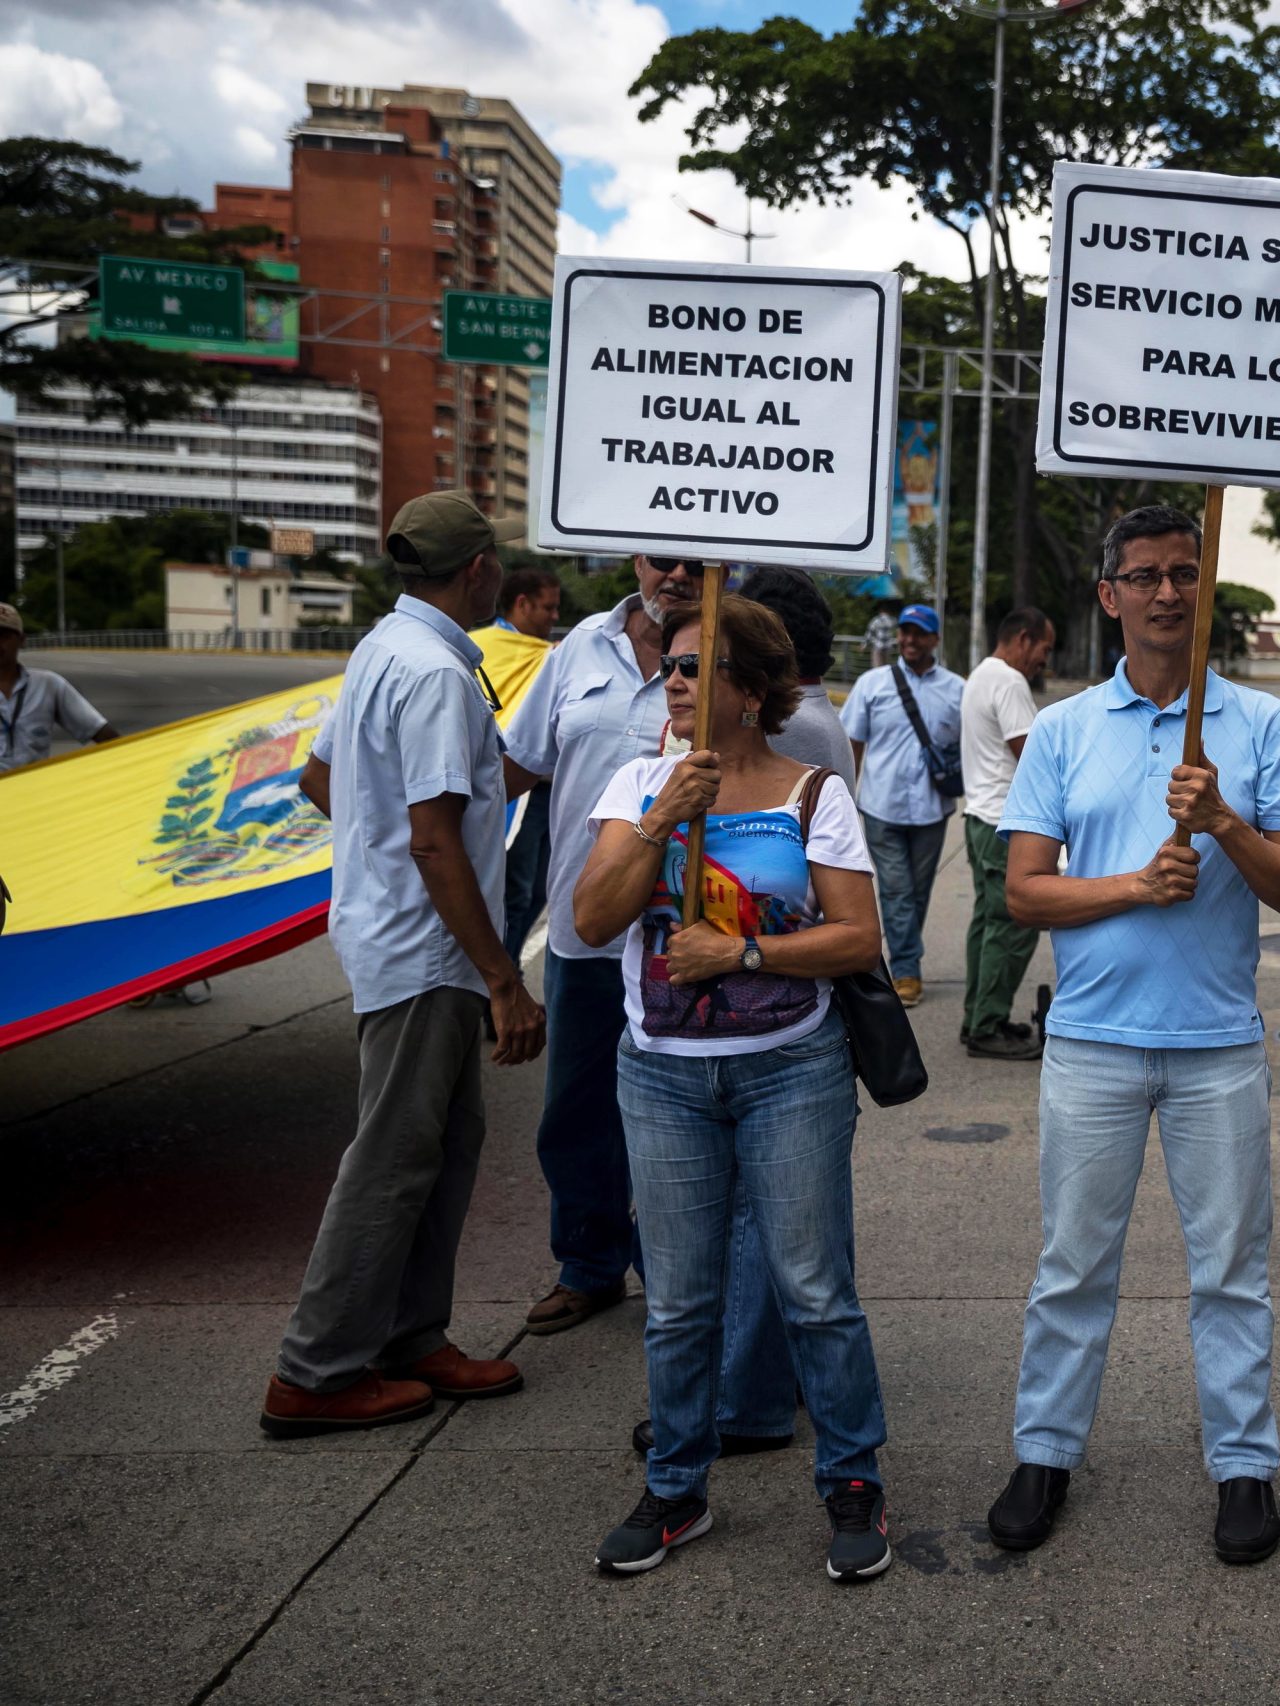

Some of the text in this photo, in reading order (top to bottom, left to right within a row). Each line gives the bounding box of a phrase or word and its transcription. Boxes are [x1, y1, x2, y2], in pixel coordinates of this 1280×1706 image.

[1080, 223, 1249, 260] JUSTICIA
[154, 270, 227, 290] MEXICO
[1071, 283, 1242, 319] SERVICIO
[114, 317, 167, 332] SALIDA
[459, 319, 495, 335] SAN
[649, 304, 802, 334] BONO DE
[591, 348, 852, 382] ALIMENTACION
[1143, 348, 1235, 378] PARA
[642, 395, 800, 425] IGUAL AL
[602, 438, 834, 473] TRABAJADOR
[649, 487, 778, 515] ACTIVO
